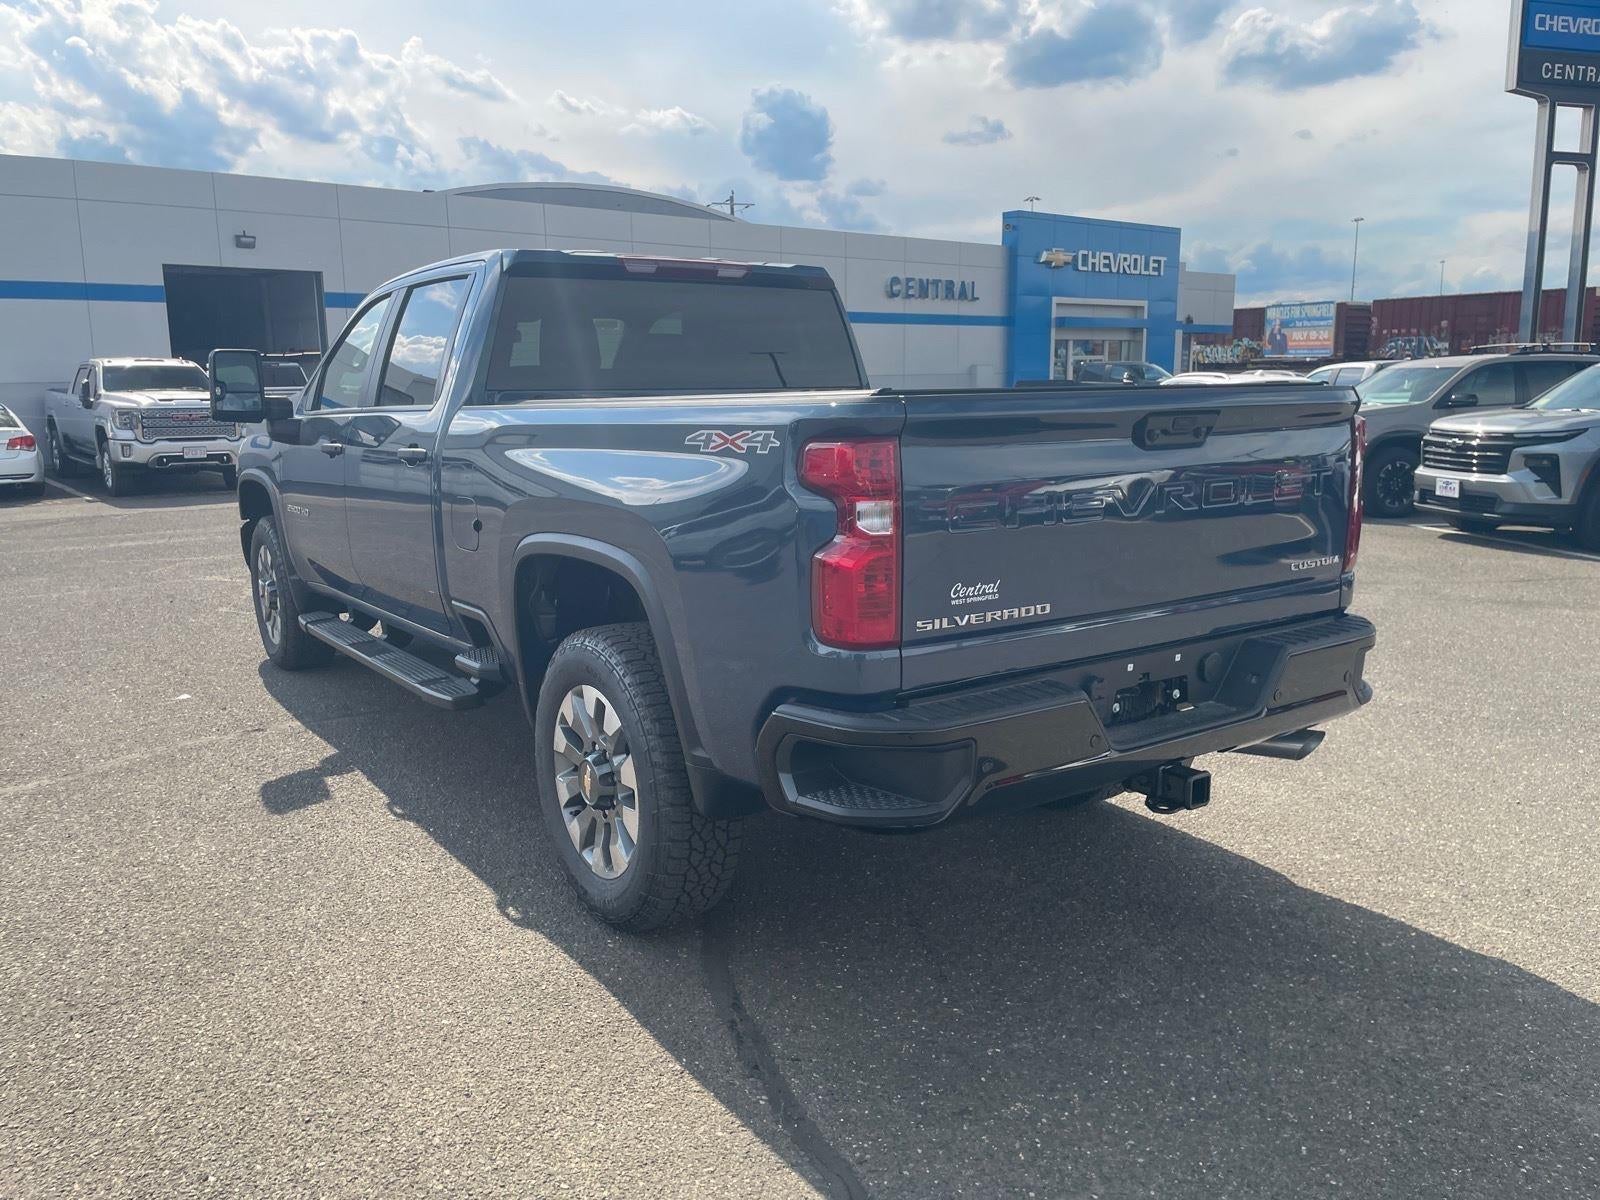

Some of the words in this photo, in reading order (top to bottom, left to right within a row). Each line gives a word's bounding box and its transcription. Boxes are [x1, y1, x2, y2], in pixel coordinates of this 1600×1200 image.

[1541, 62, 1600, 83] CENTR
[1077, 249, 1168, 277] CHEVROLET
[886, 276, 980, 302] CENTRAL
[1291, 555, 1340, 571] CUSTOM
[950, 579, 1001, 598] Central
[966, 593, 1000, 604] SPRINGFIELD
[916, 603, 1051, 632] SILVERADO
